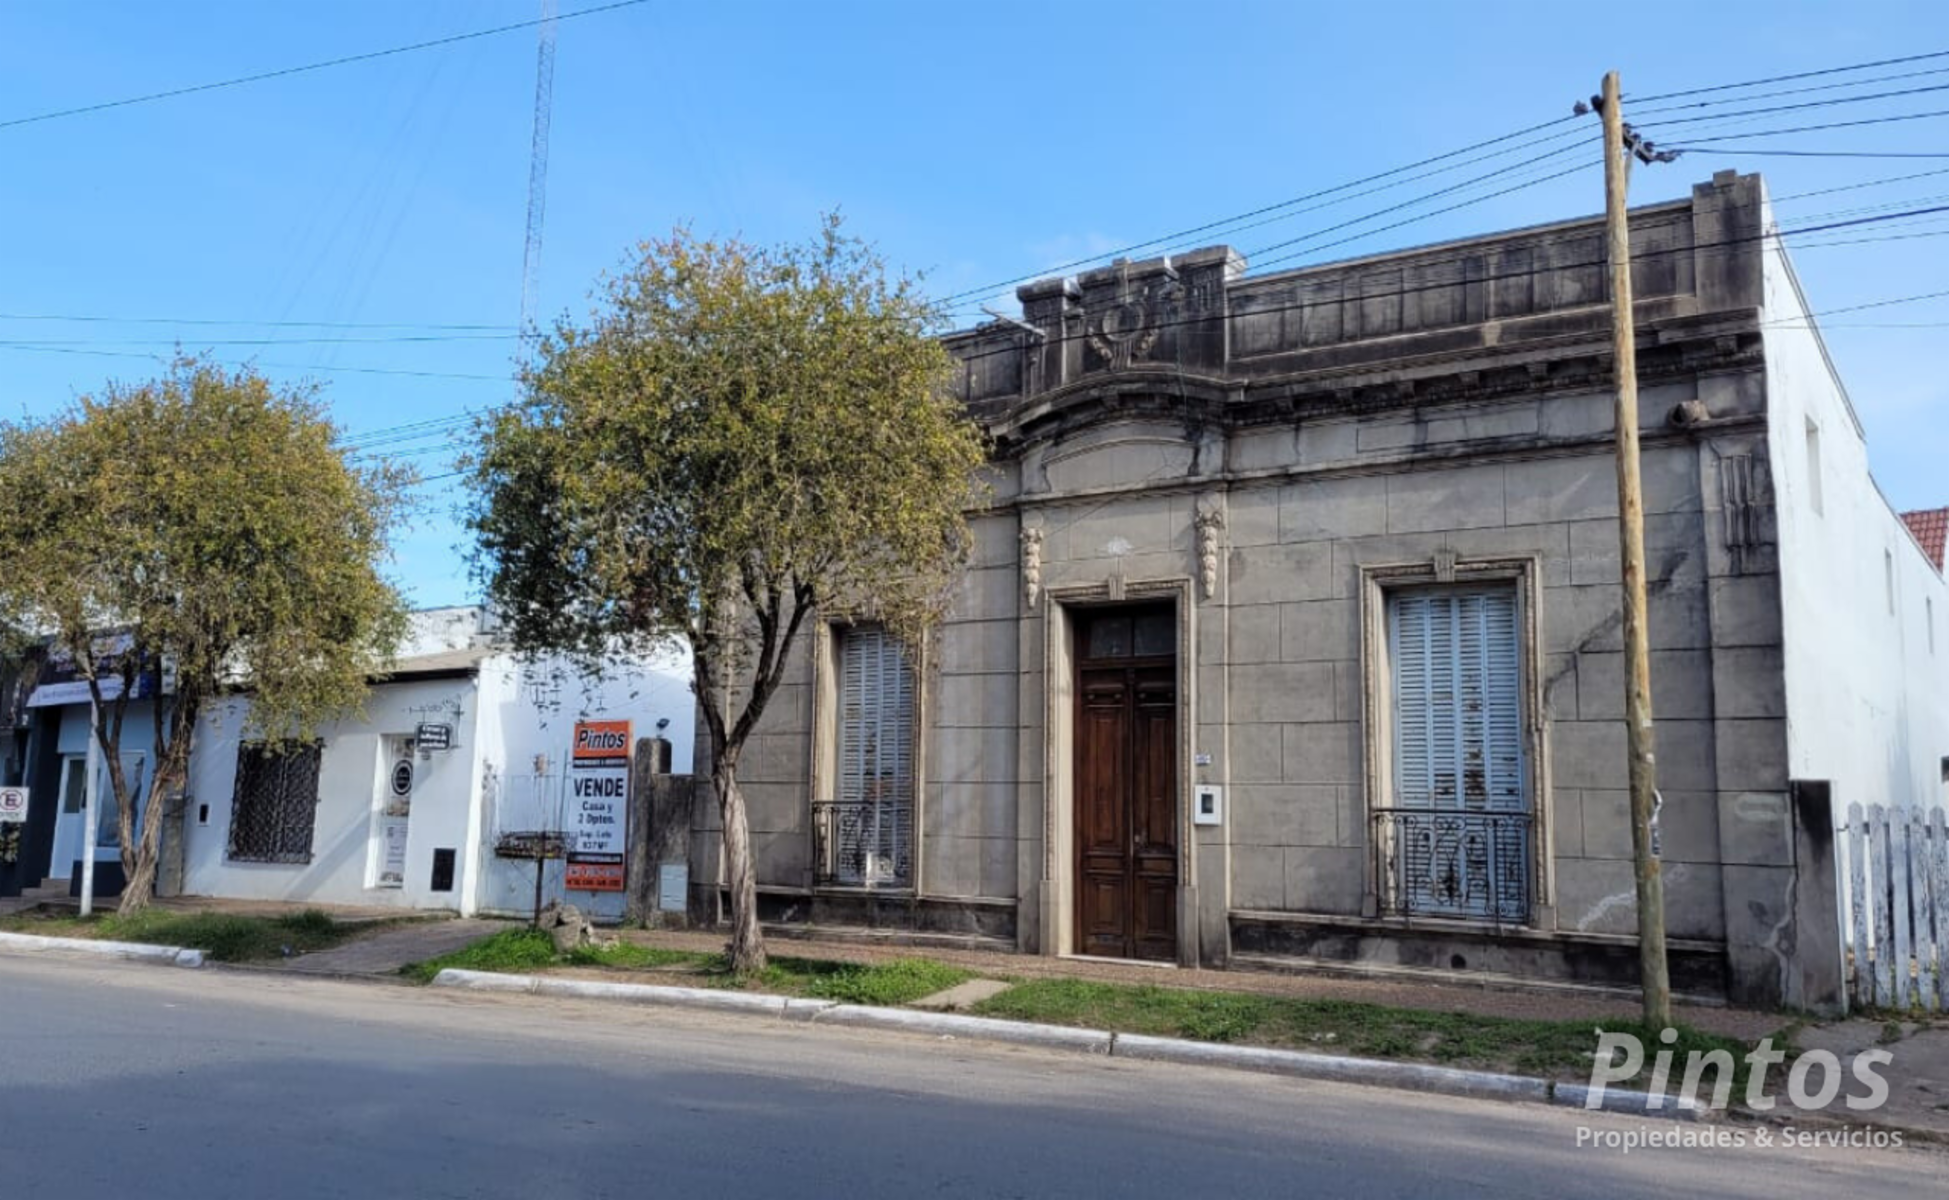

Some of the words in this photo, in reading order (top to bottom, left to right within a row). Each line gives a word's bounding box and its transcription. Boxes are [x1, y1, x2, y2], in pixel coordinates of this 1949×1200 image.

[577, 729, 626, 749] Pintos
[574, 777, 624, 797] VENDE
[582, 800, 606, 811] Casa
